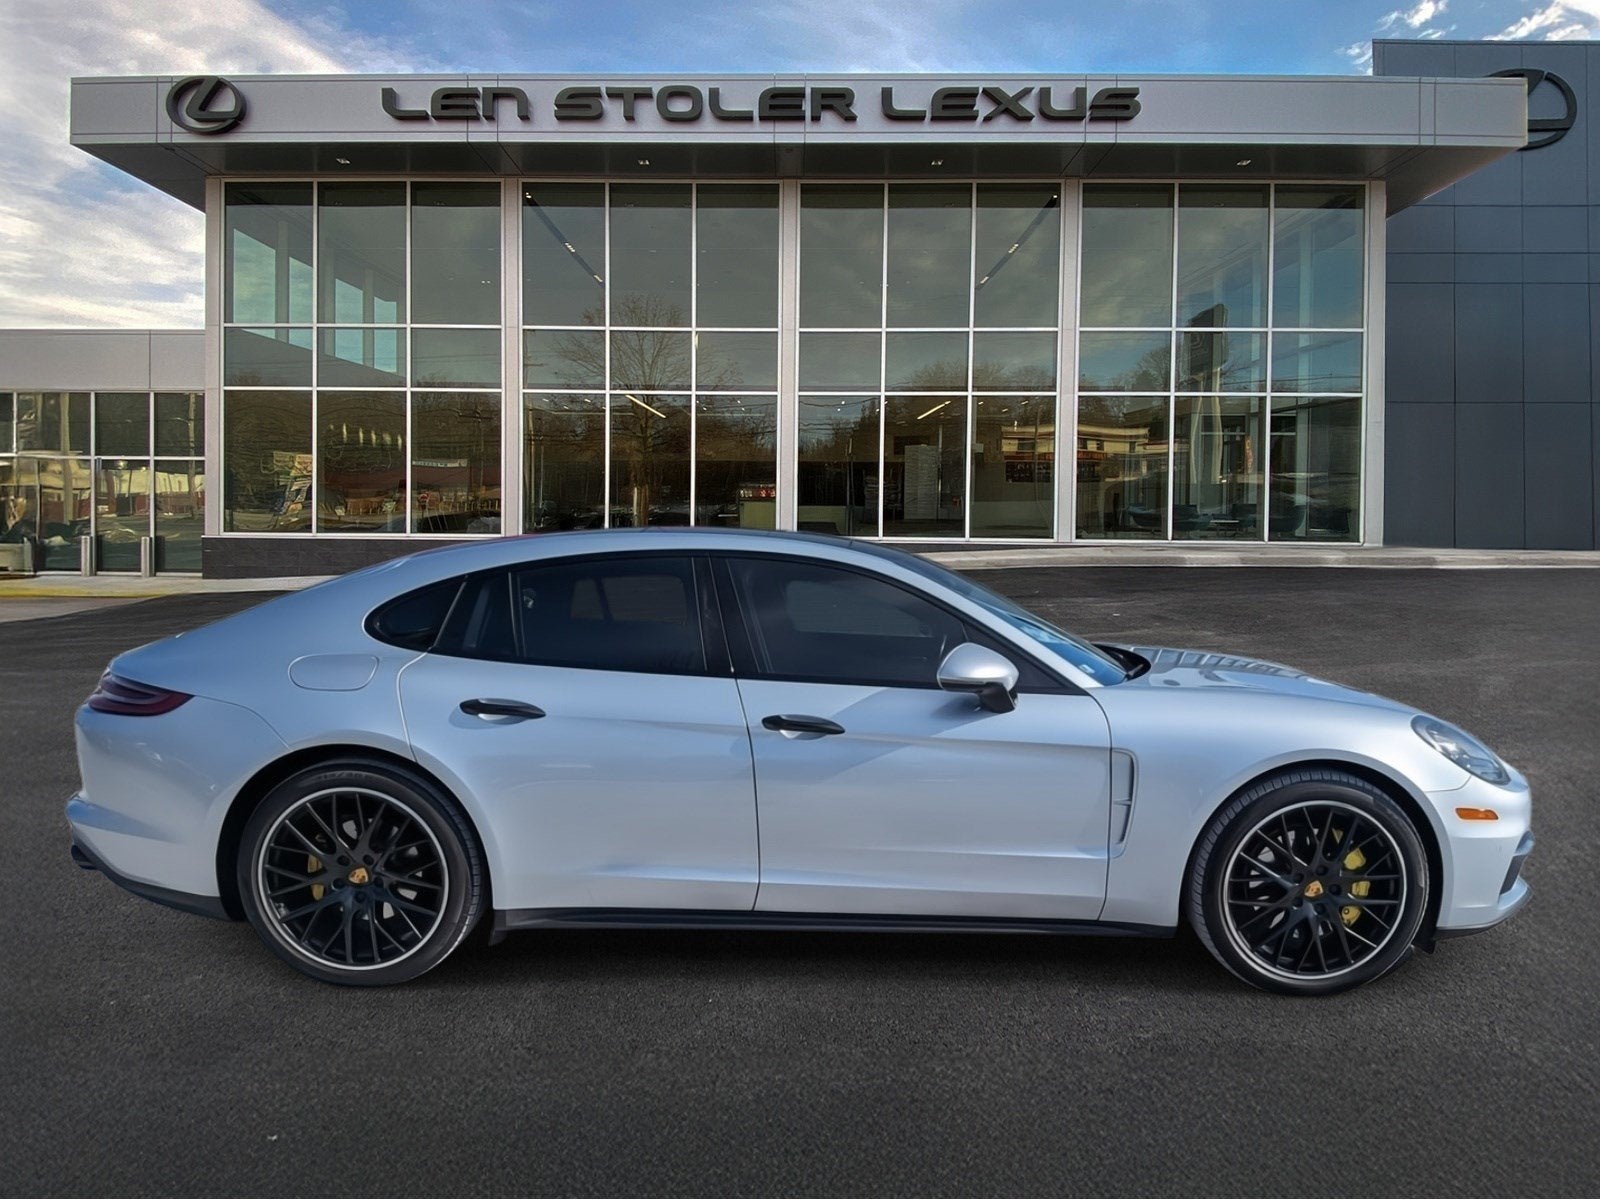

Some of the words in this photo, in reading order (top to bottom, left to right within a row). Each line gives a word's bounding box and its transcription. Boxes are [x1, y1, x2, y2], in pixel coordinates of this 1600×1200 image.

[381, 87, 531, 121] LEN
[554, 85, 858, 122] STOLER
[881, 86, 1142, 122] LEXUS
